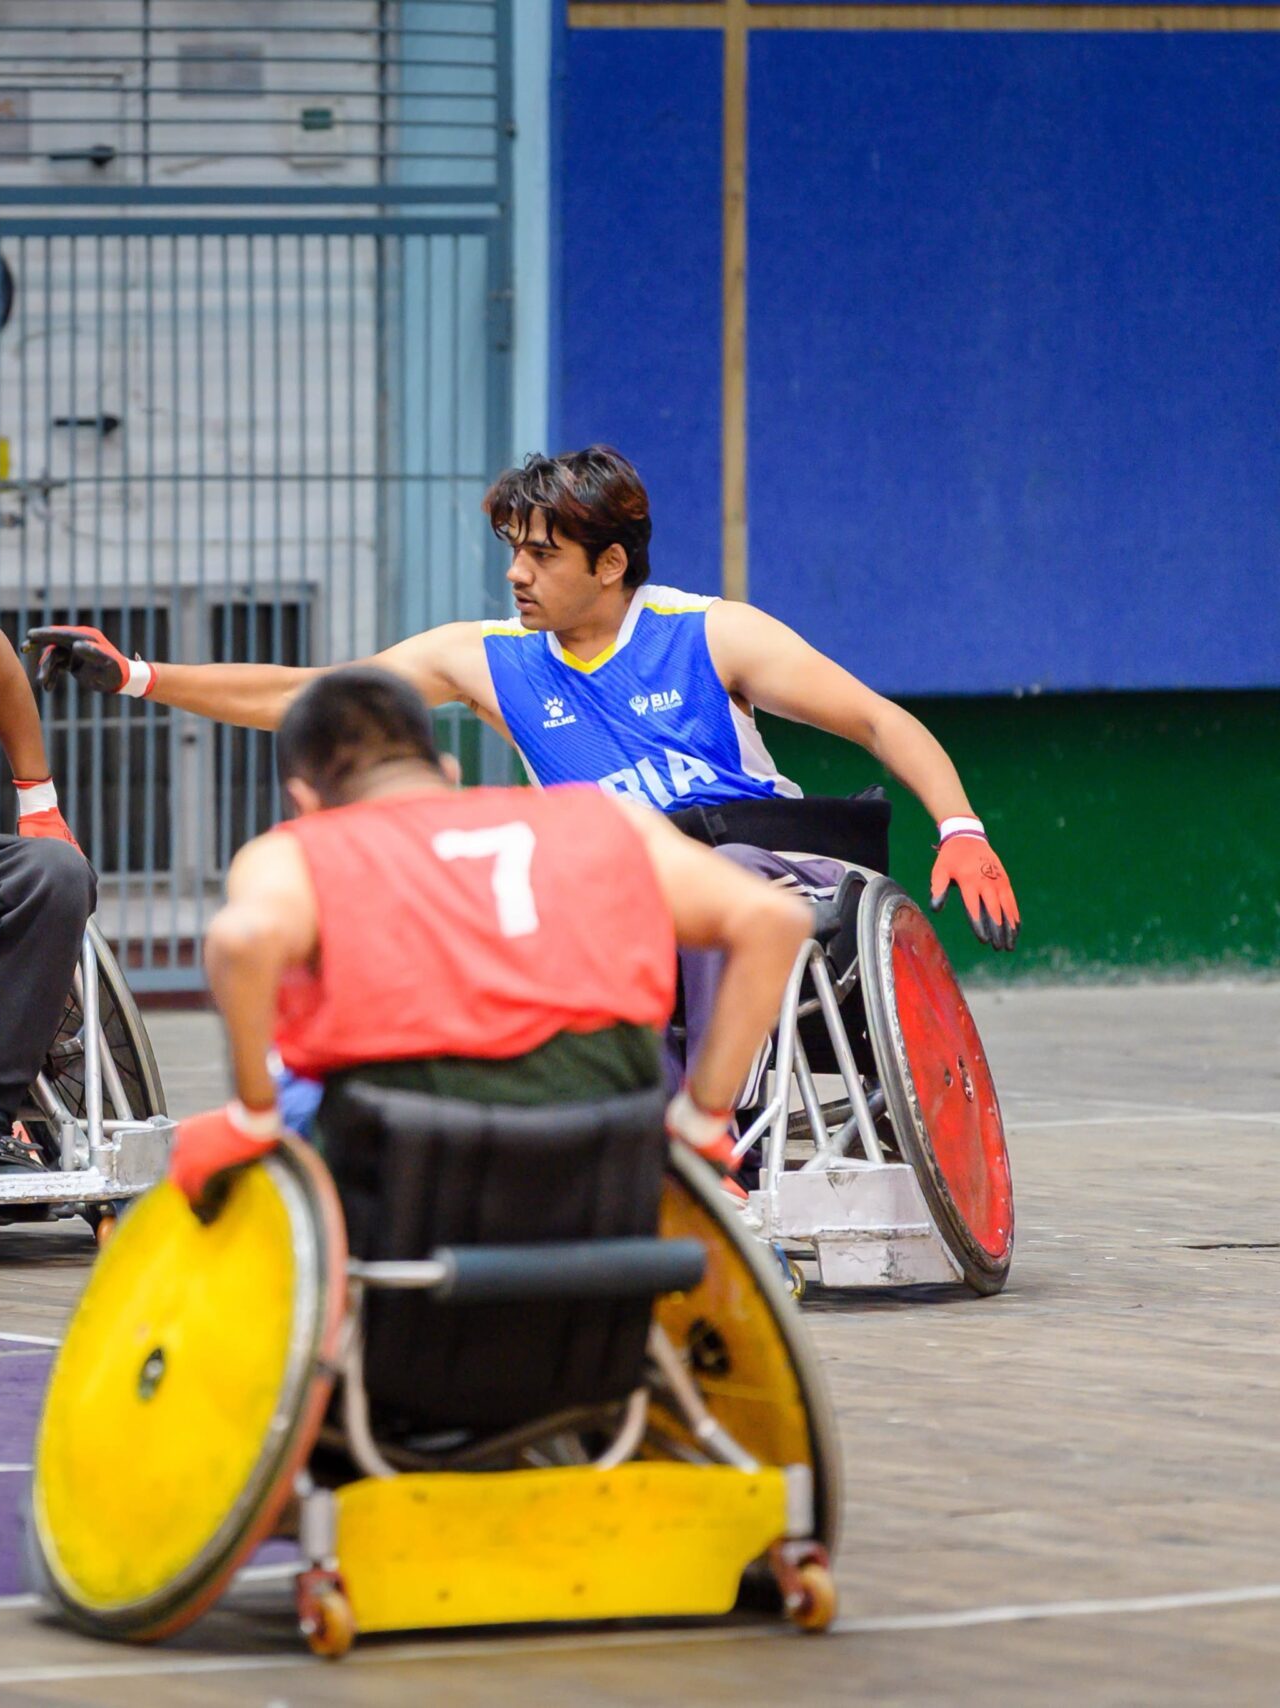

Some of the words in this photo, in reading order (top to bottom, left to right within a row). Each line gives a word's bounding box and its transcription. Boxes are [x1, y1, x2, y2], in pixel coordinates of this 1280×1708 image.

[650, 689, 682, 707] BIA
[543, 714, 576, 729] KELME
[597, 747, 719, 808] BIA
[431, 820, 540, 939] 7
